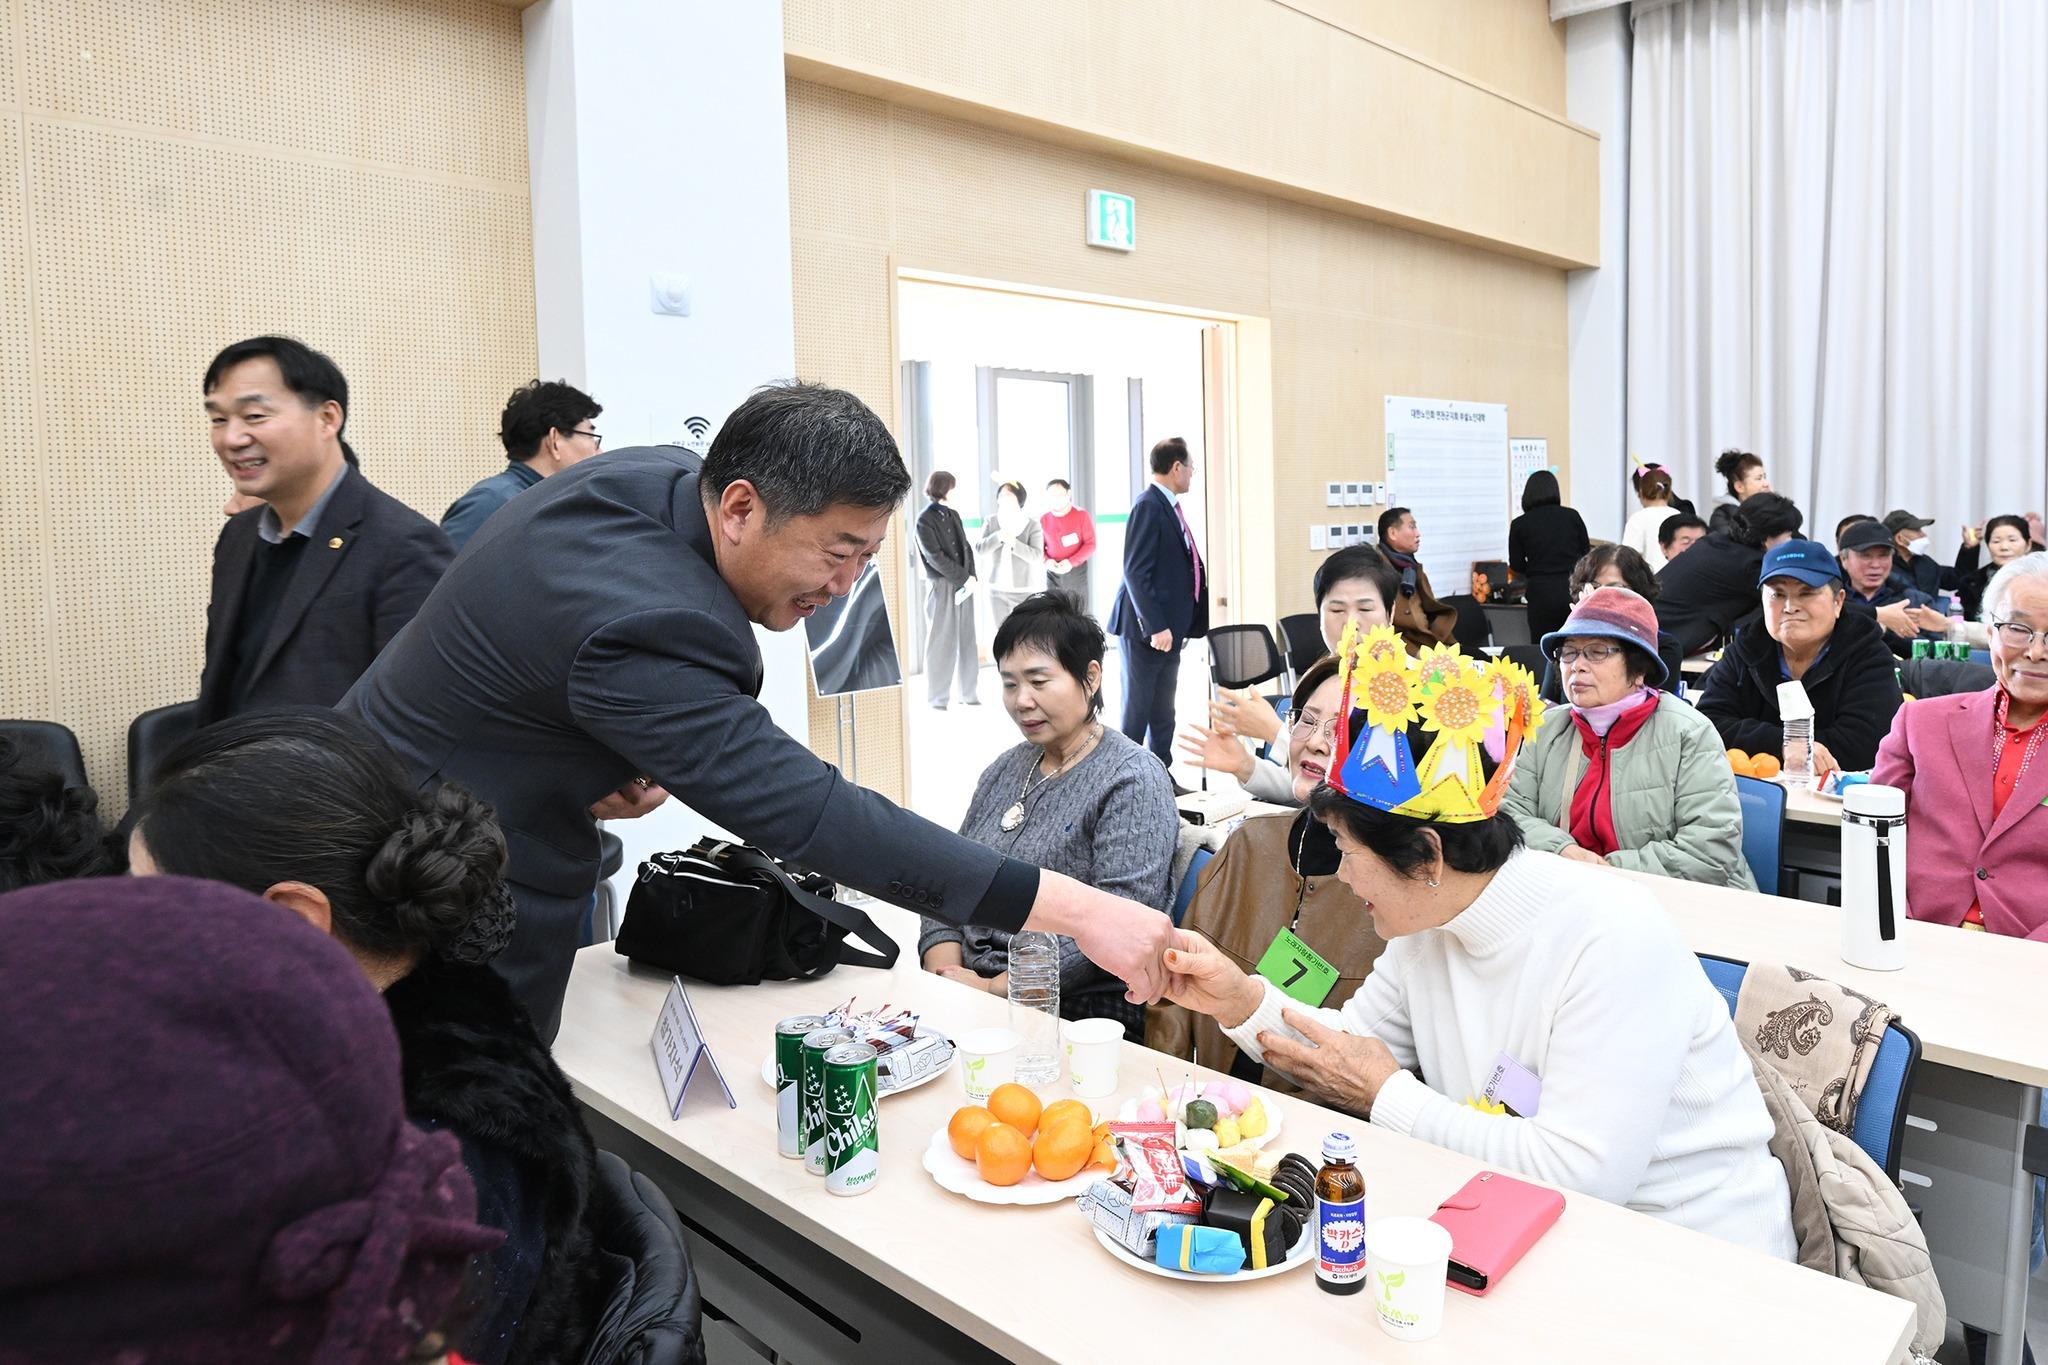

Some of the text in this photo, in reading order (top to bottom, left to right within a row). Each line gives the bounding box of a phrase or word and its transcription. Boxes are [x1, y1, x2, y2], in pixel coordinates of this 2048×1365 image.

[1284, 935, 1330, 976] 노래자랑참가번호
[1282, 958, 1309, 989] 7
[1326, 1226, 1361, 1240] 박카스
[1341, 1241, 1350, 1249] D
